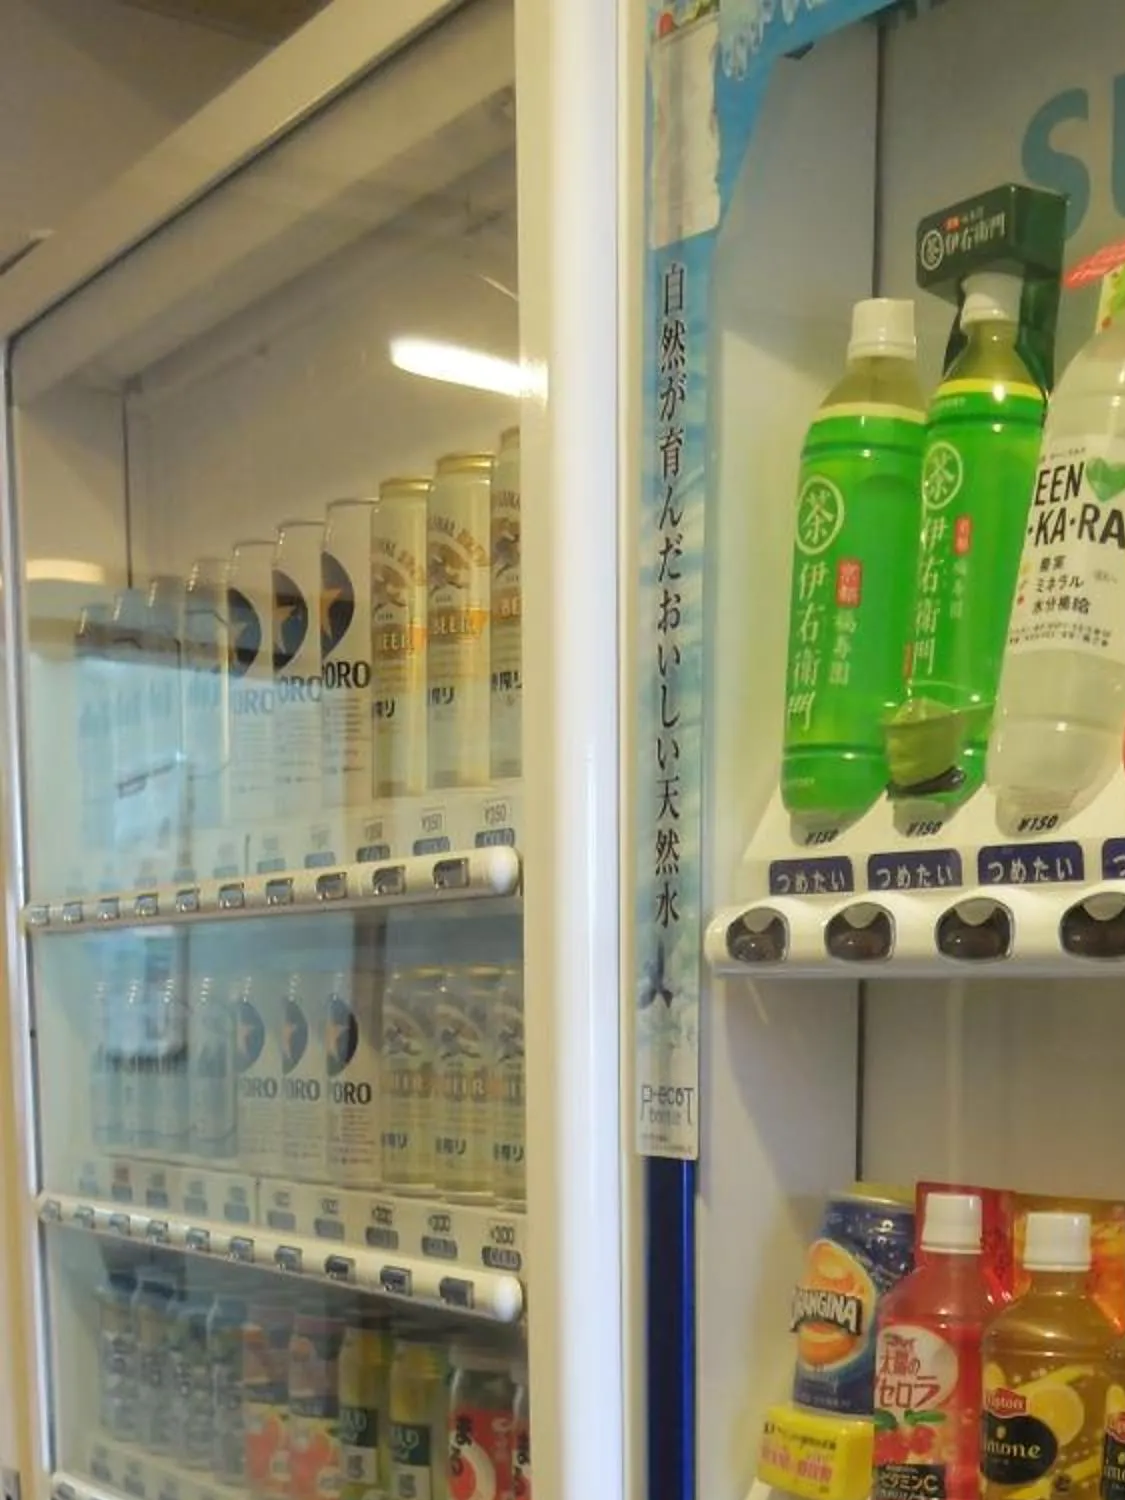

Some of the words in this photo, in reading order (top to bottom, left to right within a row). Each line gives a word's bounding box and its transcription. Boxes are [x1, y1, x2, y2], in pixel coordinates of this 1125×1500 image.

[1035, 573, 1085, 593] ミネラル
[655, 262, 686, 930] 自然が育んだおいしい天然水
[1032, 595, 1091, 616] 水分補給
[776, 869, 845, 893] つめたい
[876, 863, 953, 888] つめたい
[987, 856, 1073, 882] つめたい
